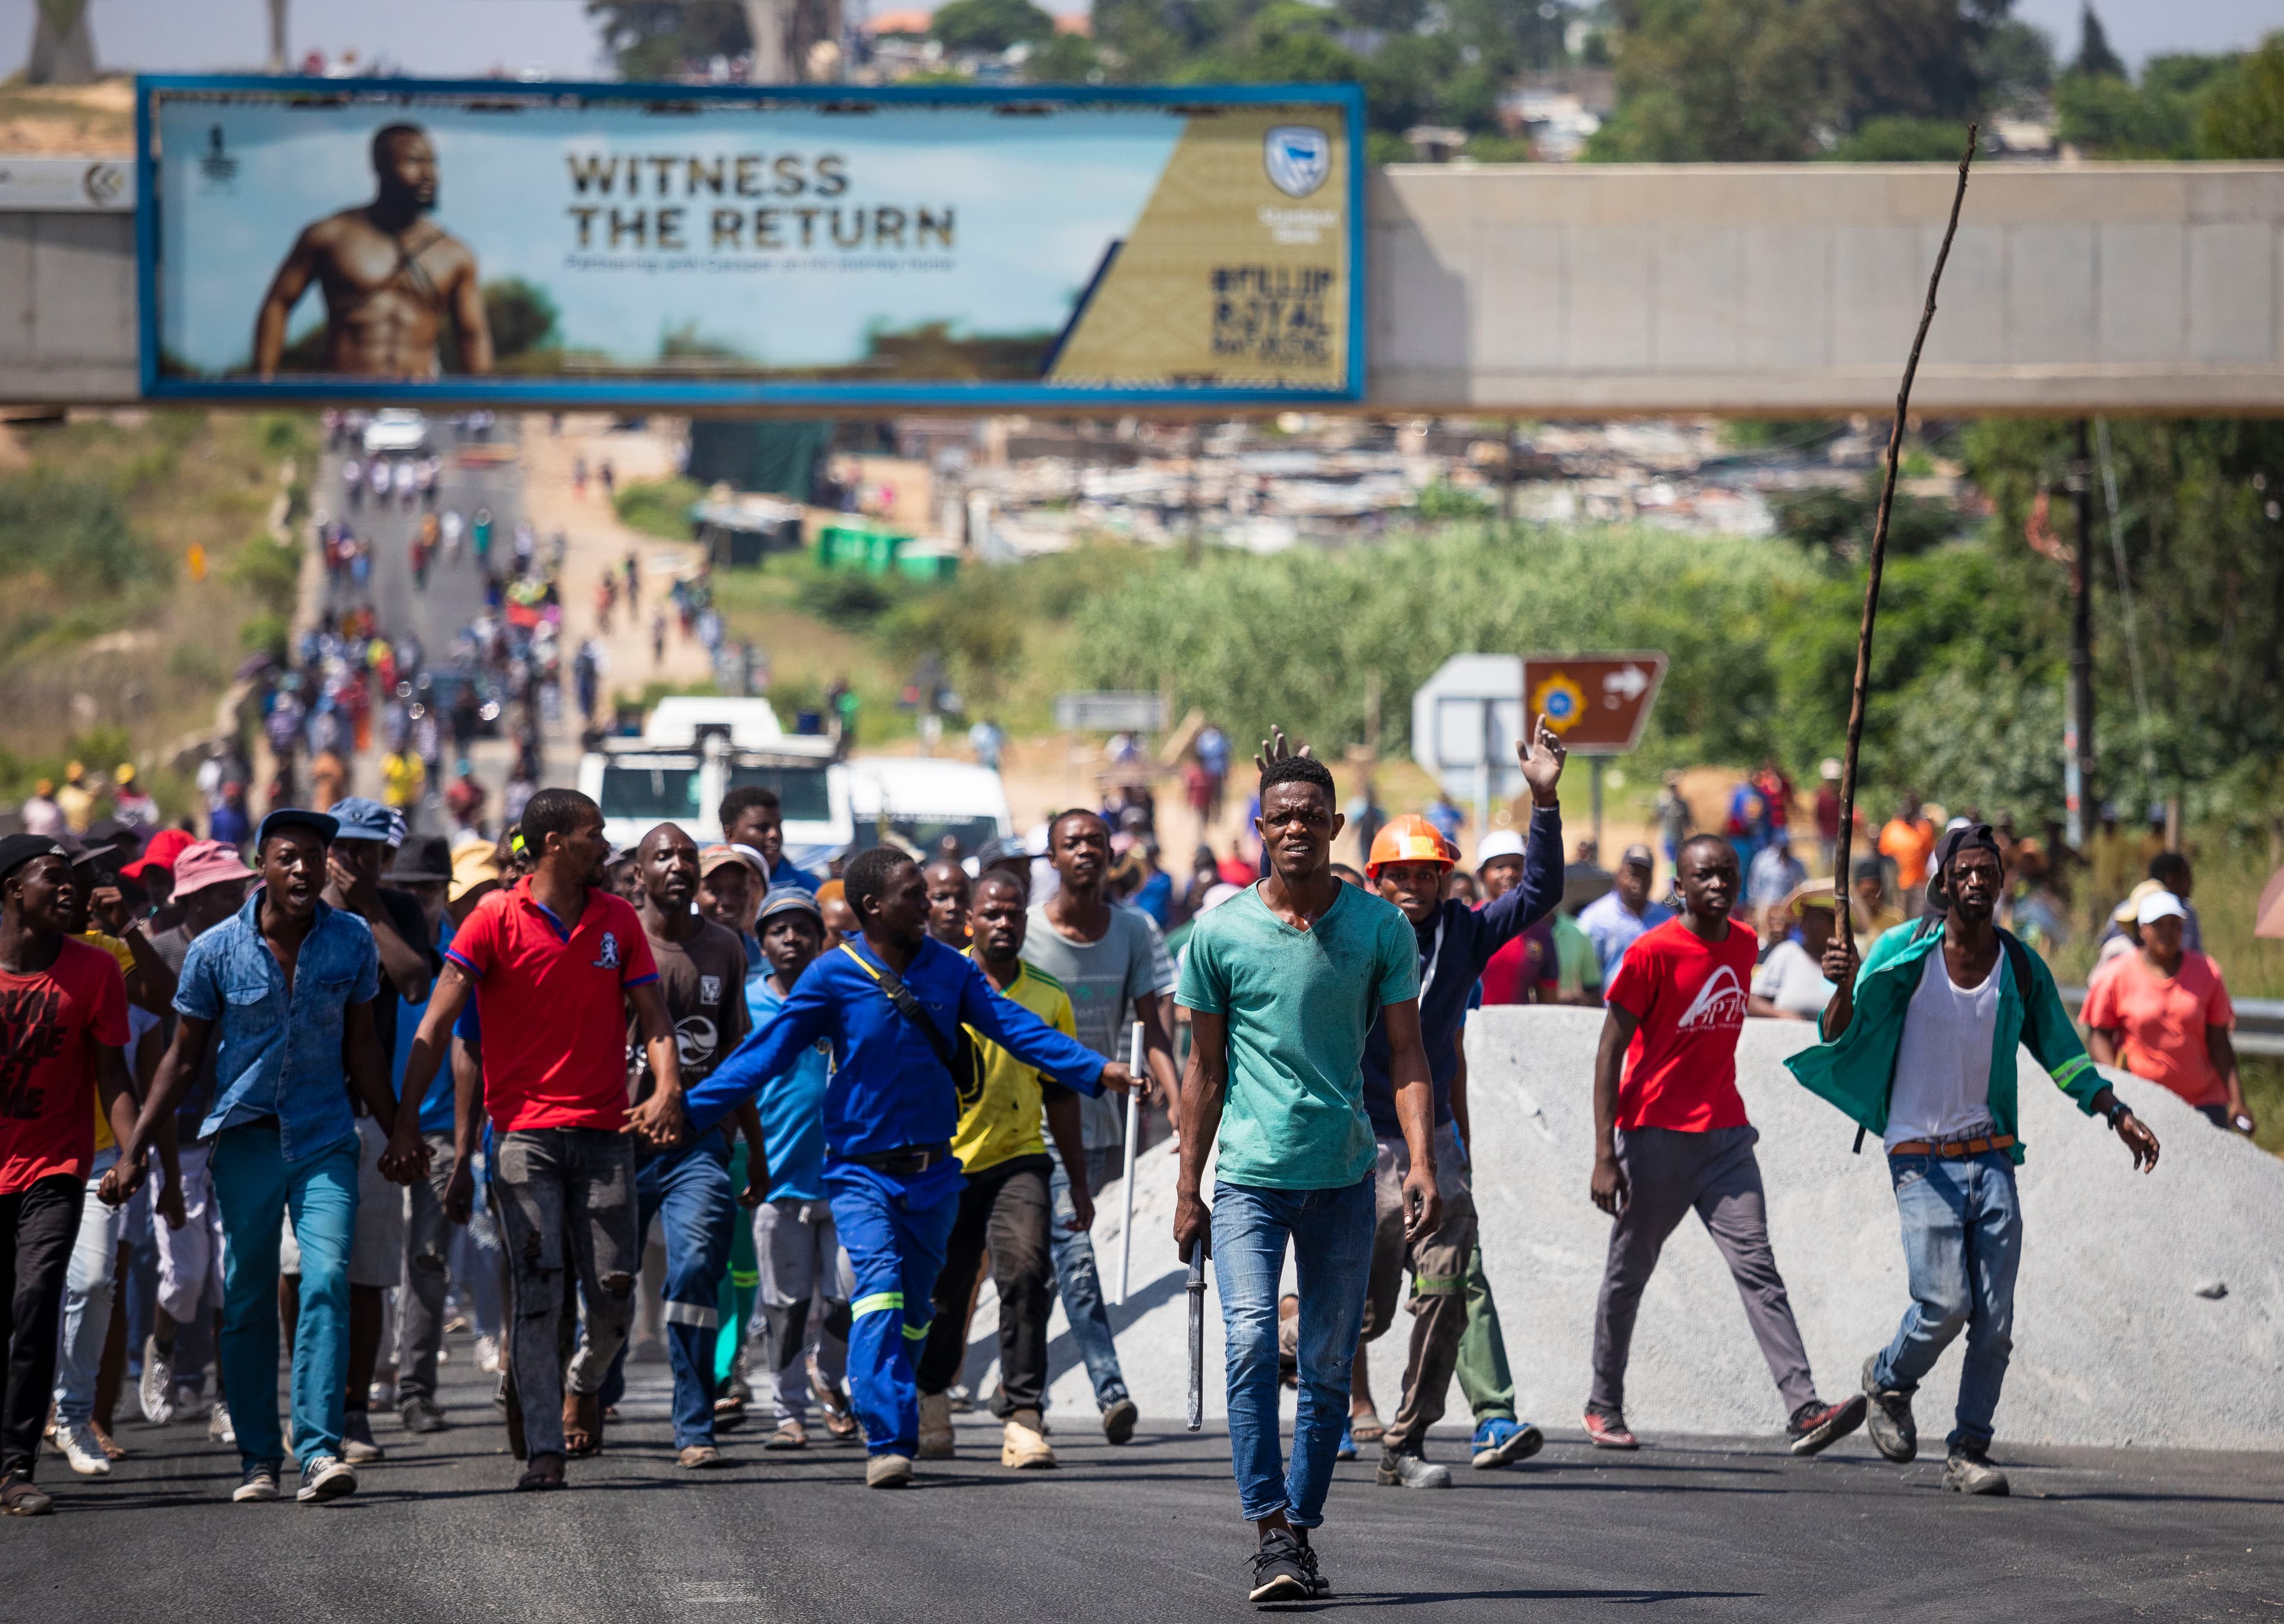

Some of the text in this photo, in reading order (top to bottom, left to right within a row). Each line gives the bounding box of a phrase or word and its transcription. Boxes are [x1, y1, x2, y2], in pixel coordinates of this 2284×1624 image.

[567, 155, 849, 197] WITNESS
[567, 206, 959, 250] THE RETURN
